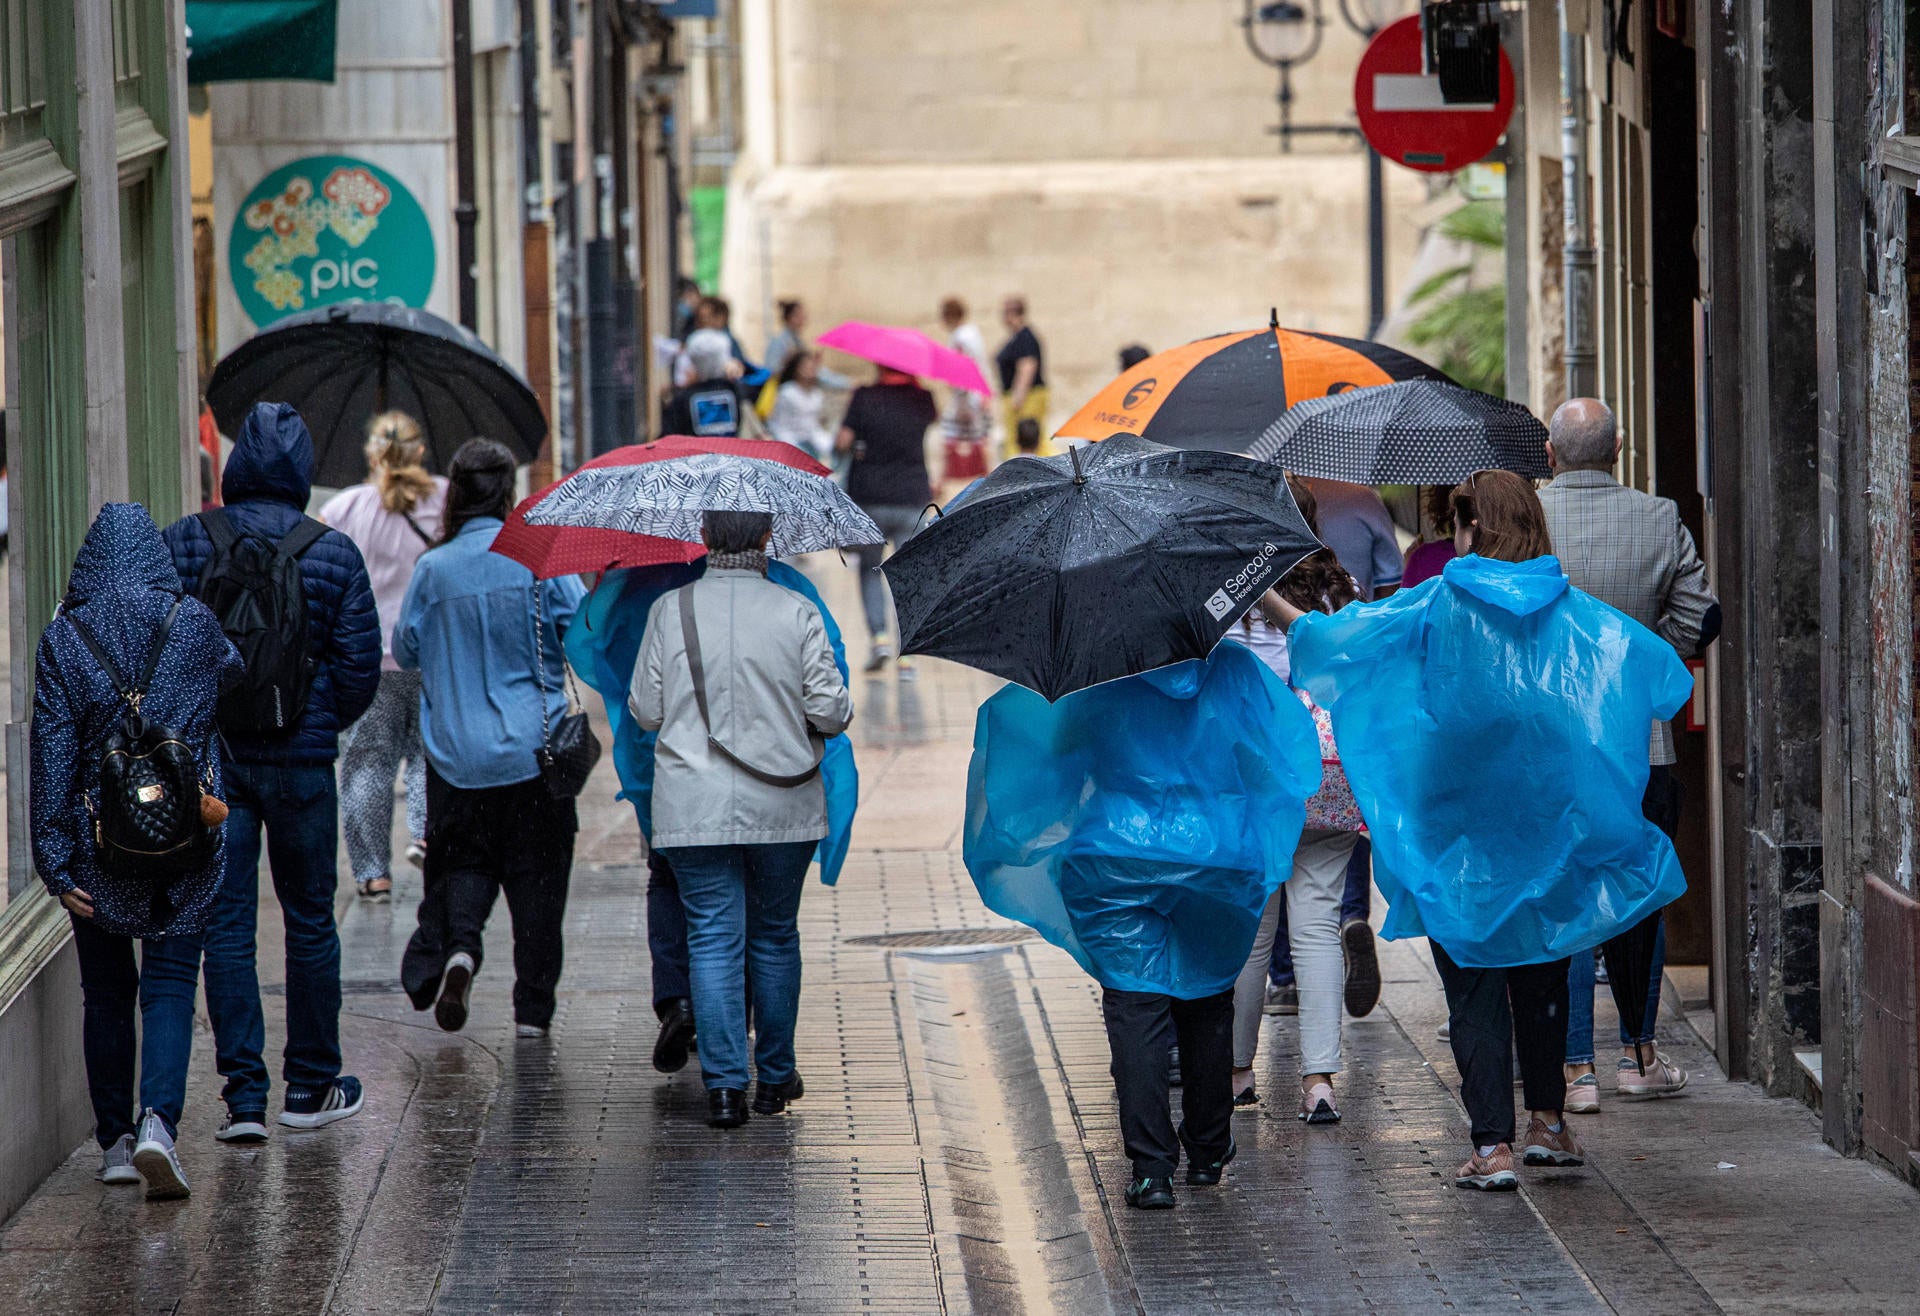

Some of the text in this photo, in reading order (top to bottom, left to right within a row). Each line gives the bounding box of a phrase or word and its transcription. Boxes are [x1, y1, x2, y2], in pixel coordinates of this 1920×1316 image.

[311, 249, 378, 298] pic
[1225, 542, 1278, 593] Sercotel
[1234, 565, 1272, 602] Hotel Group
[1211, 596, 1226, 612] S
